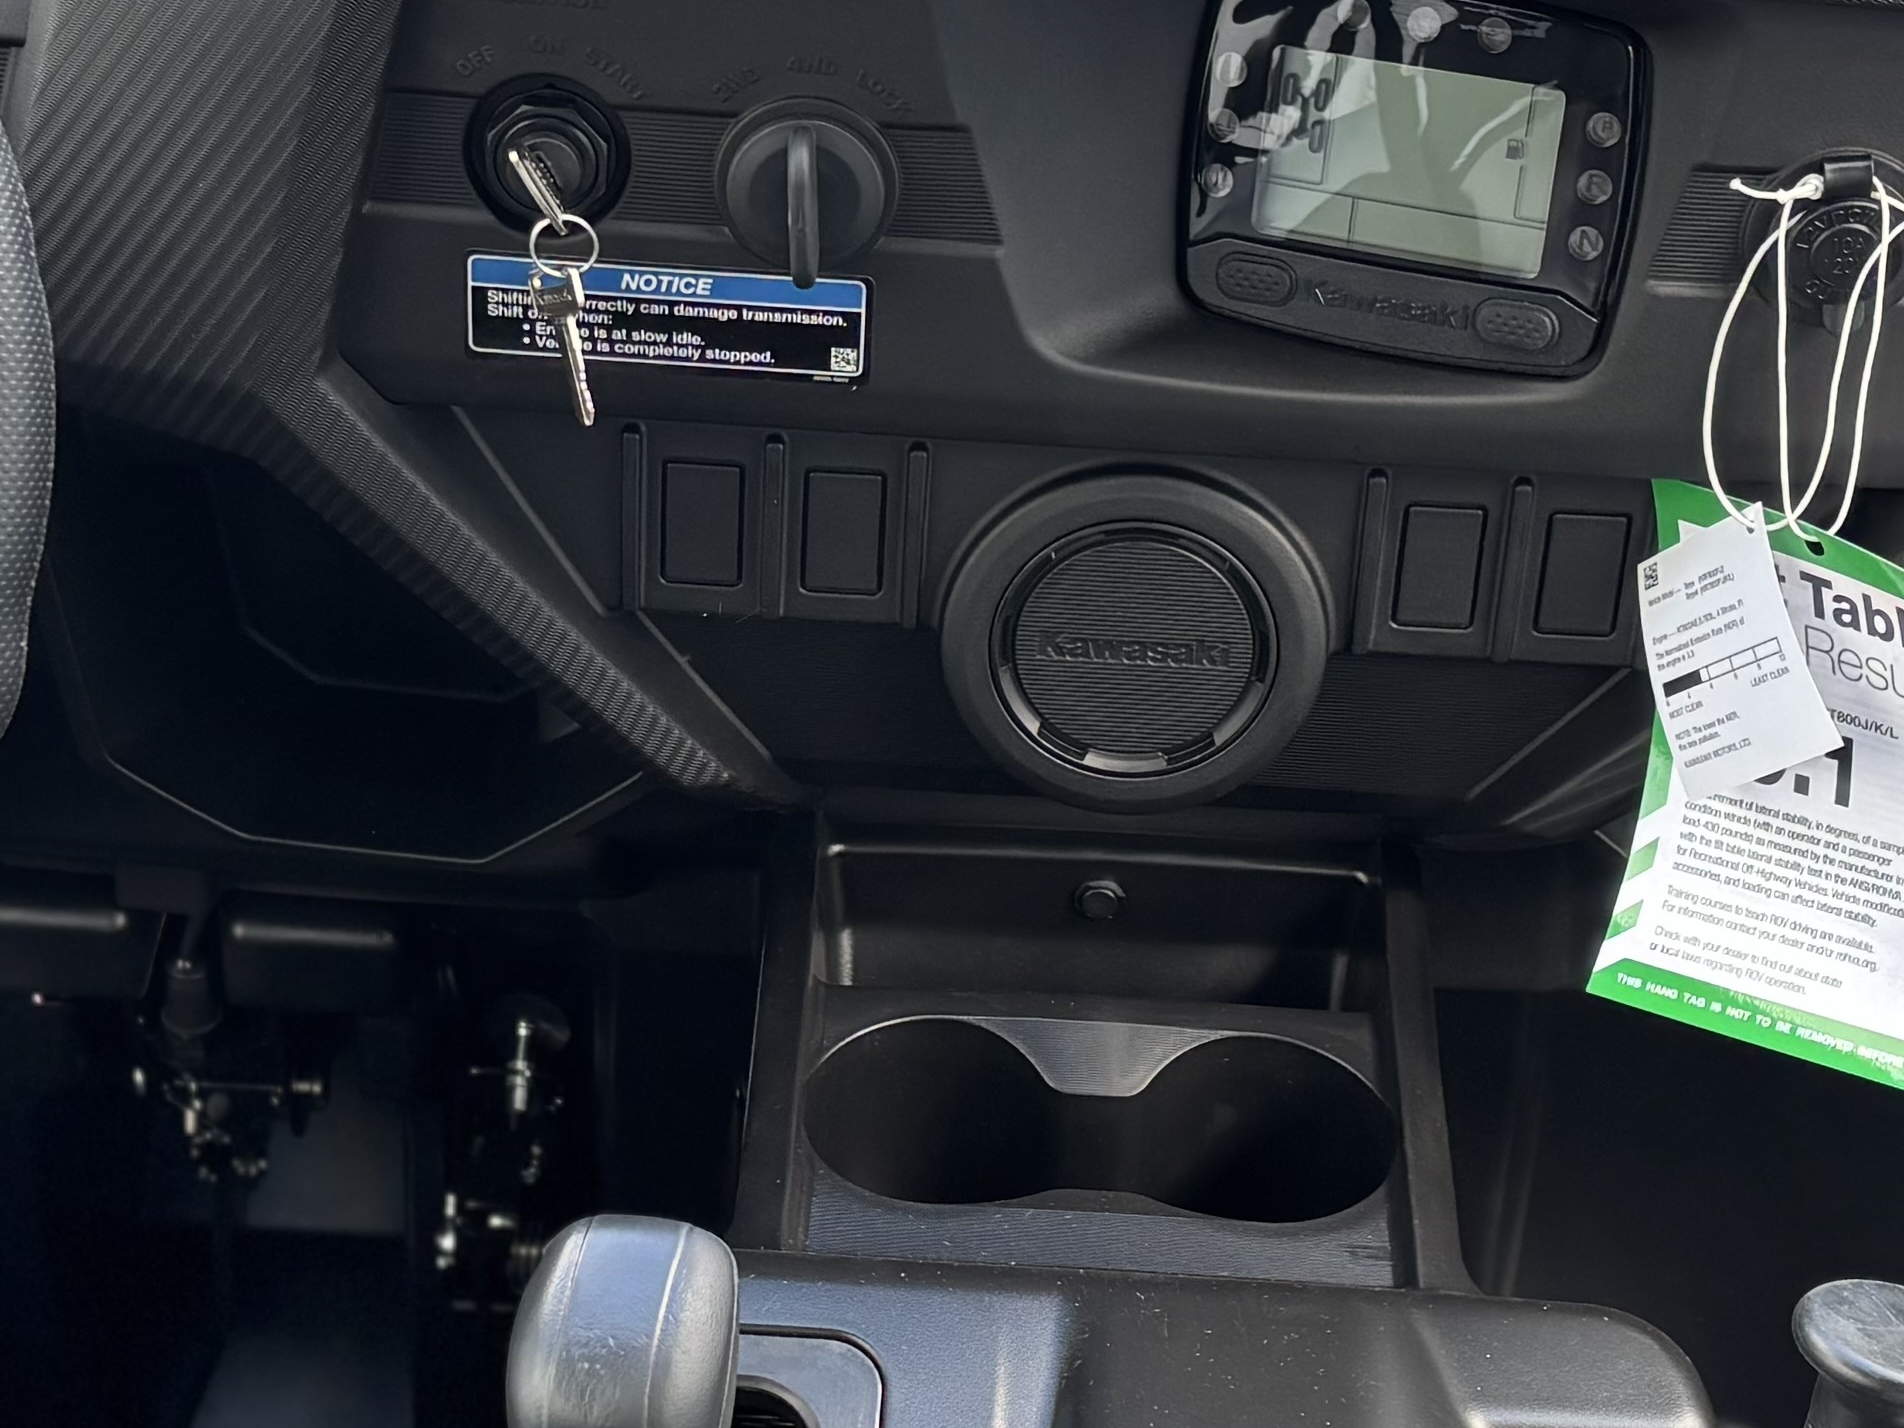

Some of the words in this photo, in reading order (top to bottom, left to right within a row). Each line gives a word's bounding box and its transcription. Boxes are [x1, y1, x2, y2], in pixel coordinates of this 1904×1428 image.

[454, 42, 497, 78] OFF
[621, 274, 713, 295] NOTICE
[487, 304, 523, 319] Shift
[640, 304, 669, 316] can
[673, 303, 738, 322] damage
[742, 309, 847, 327] transmission.
[1303, 277, 1470, 332] Kawasaki
[593, 326, 607, 338] is
[611, 328, 627, 340] at
[631, 329, 668, 344] slow
[672, 331, 706, 346] idle.
[596, 339, 610, 352] is
[614, 341, 701, 361] completely
[705, 347, 776, 365] stopped.
[1035, 631, 1231, 668] Kawasaki
[1617, 972, 1642, 989] THIS
[1646, 981, 1678, 999] HANG
[1683, 992, 1706, 1008] TAG
[1710, 1000, 1722, 1013] IS
[1726, 1005, 1752, 1022] NOT
[1755, 1013, 1773, 1028] TO
[1775, 1019, 1792, 1034] BE
[1796, 1024, 1855, 1053] REMOVED
